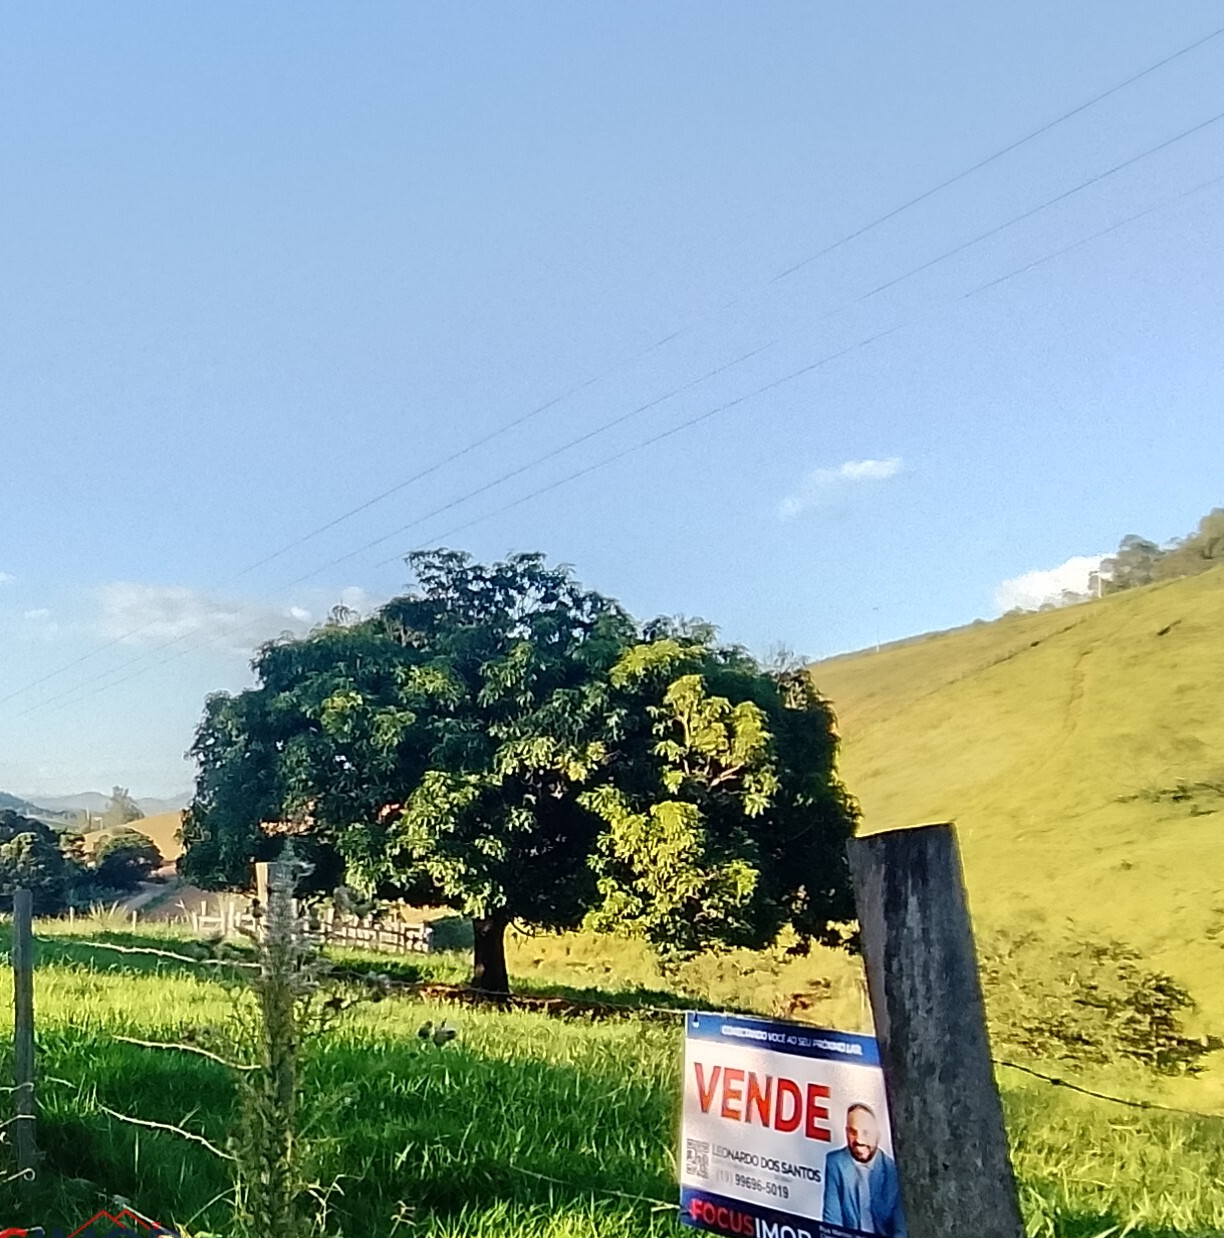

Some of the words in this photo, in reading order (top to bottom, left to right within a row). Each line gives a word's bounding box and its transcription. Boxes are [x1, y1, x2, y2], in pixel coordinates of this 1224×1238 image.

[787, 1036, 797, 1045] AO
[798, 1037, 811, 1047] SEU
[694, 1062, 832, 1142] VENDE
[712, 1143, 759, 1166] LEONARDO
[761, 1157, 780, 1172] DOS
[781, 1161, 822, 1182] SANTOS
[735, 1173, 789, 1198] 99696-5019
